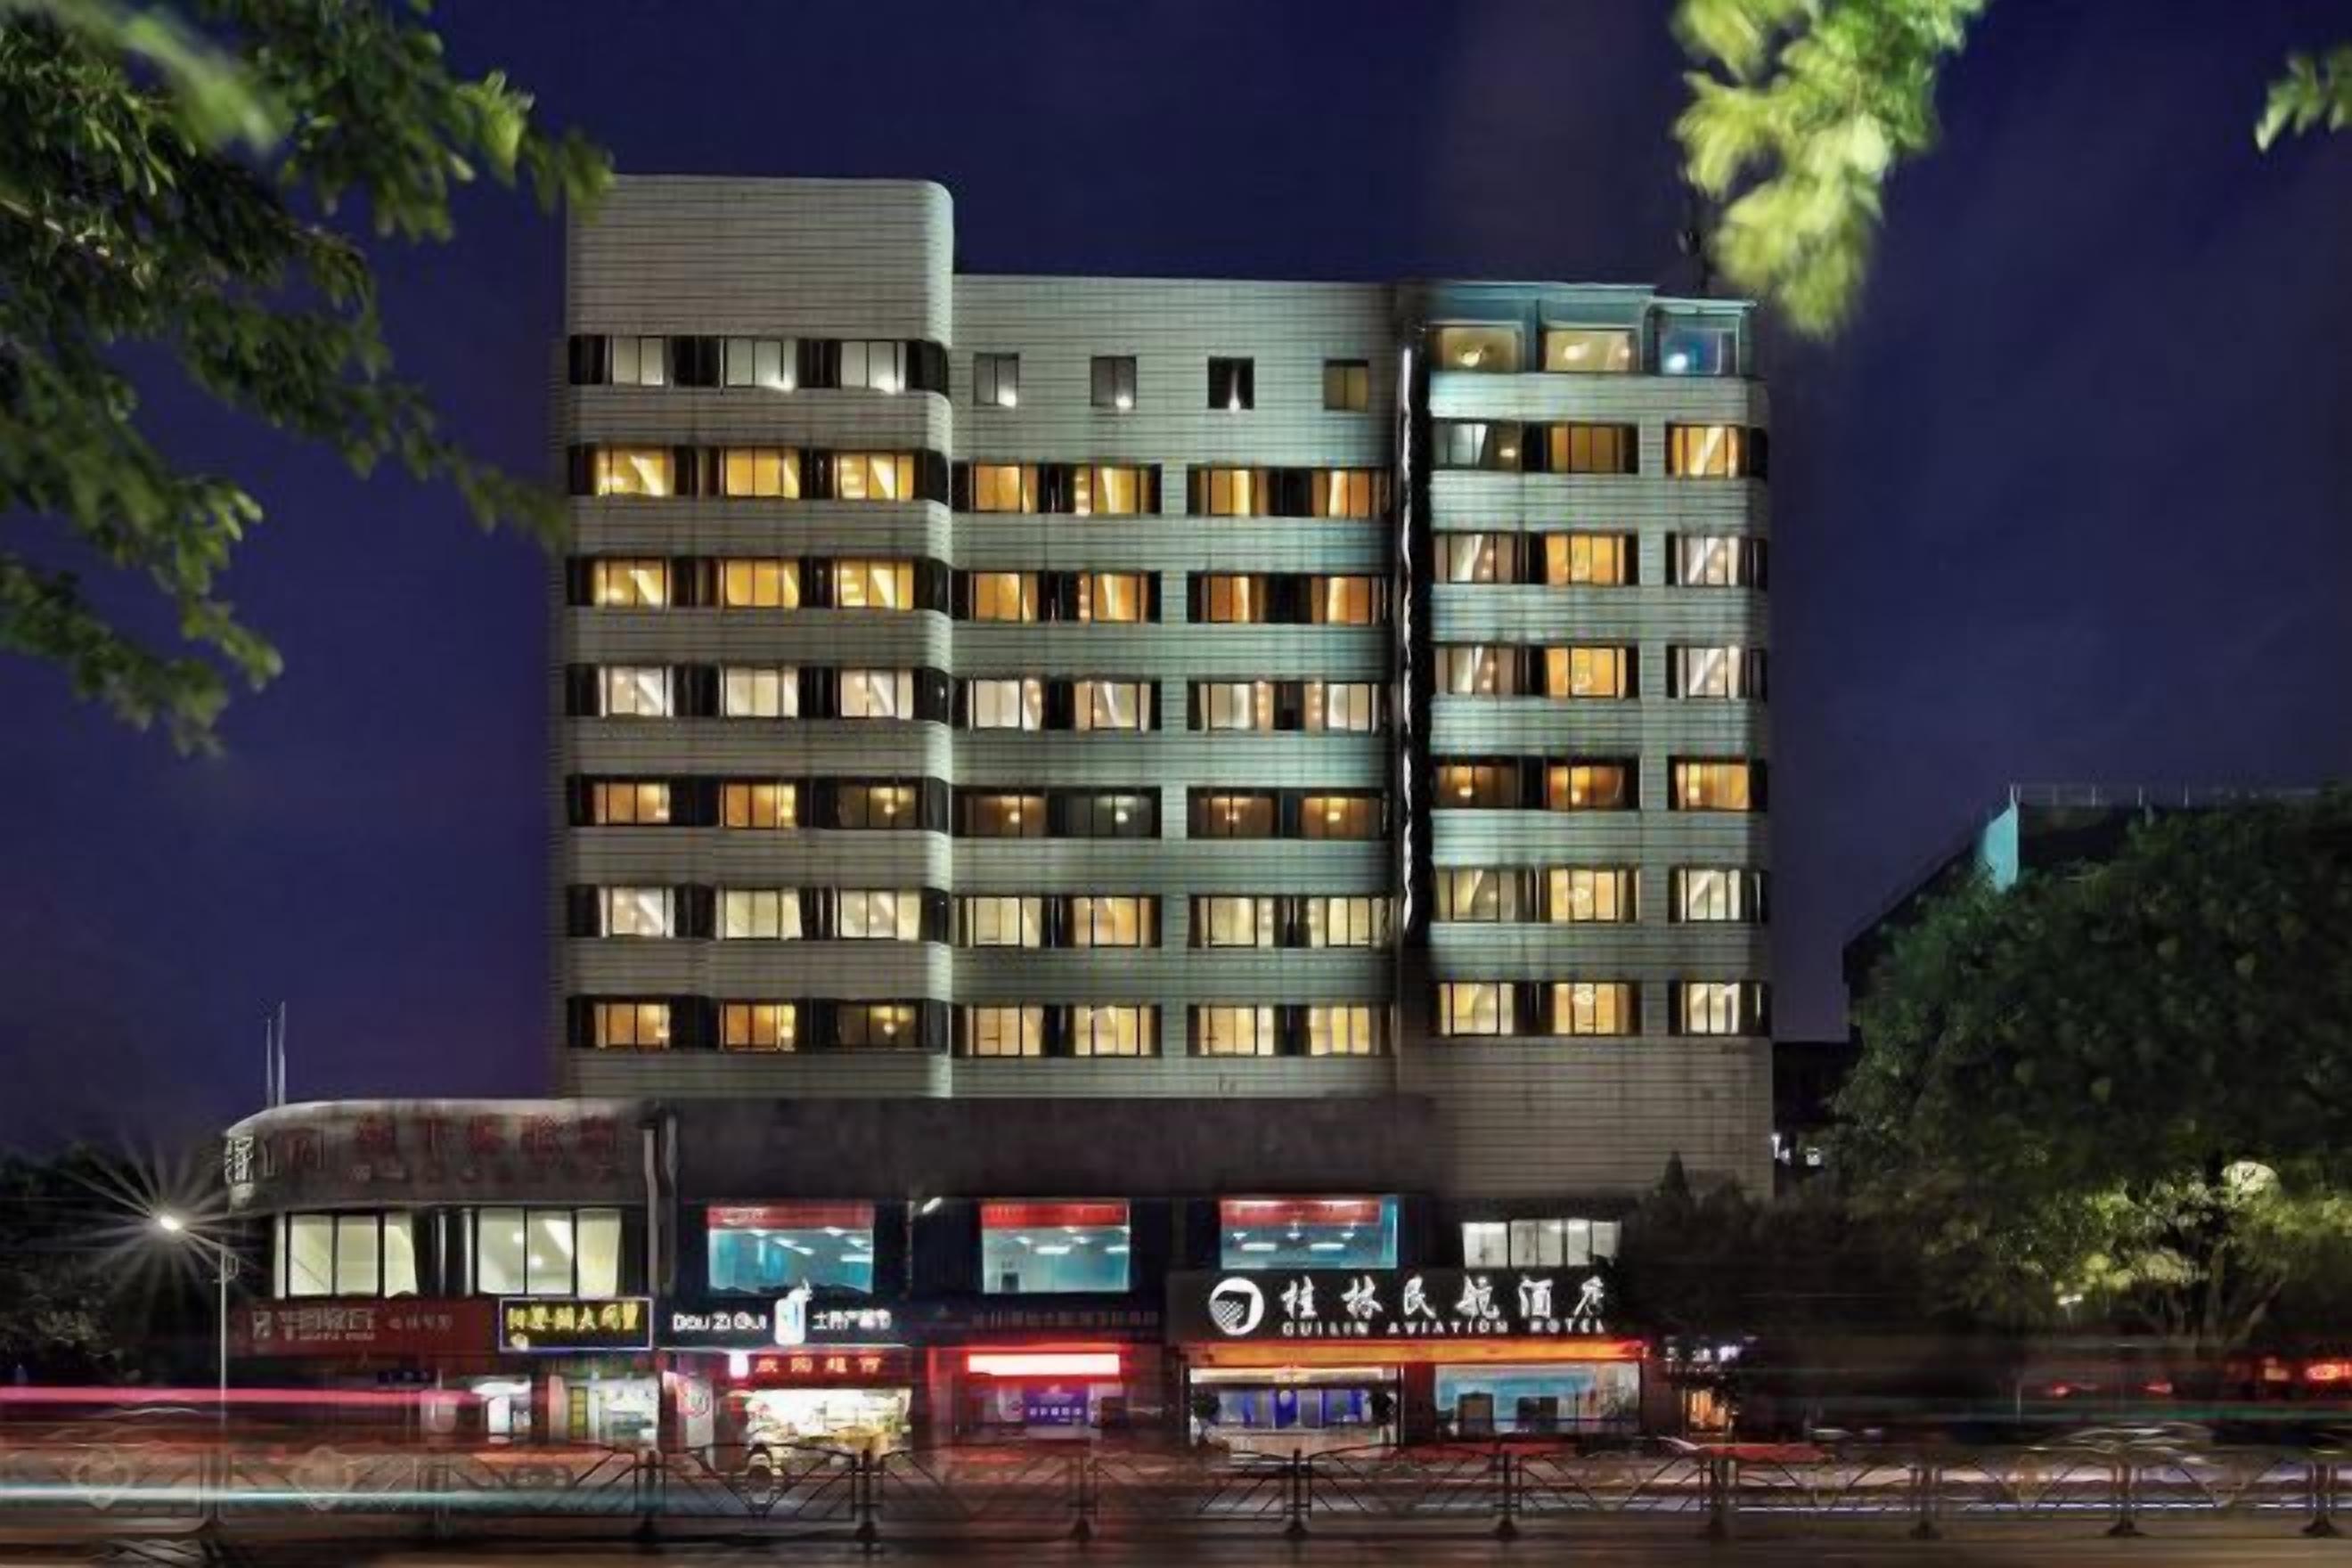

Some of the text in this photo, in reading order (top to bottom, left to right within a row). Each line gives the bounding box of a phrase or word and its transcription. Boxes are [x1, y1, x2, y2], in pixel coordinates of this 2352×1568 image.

[1280, 1275, 1604, 1319] 桂林民航酒店
[1282, 1318, 1604, 1336] GUILIN AVIATION HOTEL
